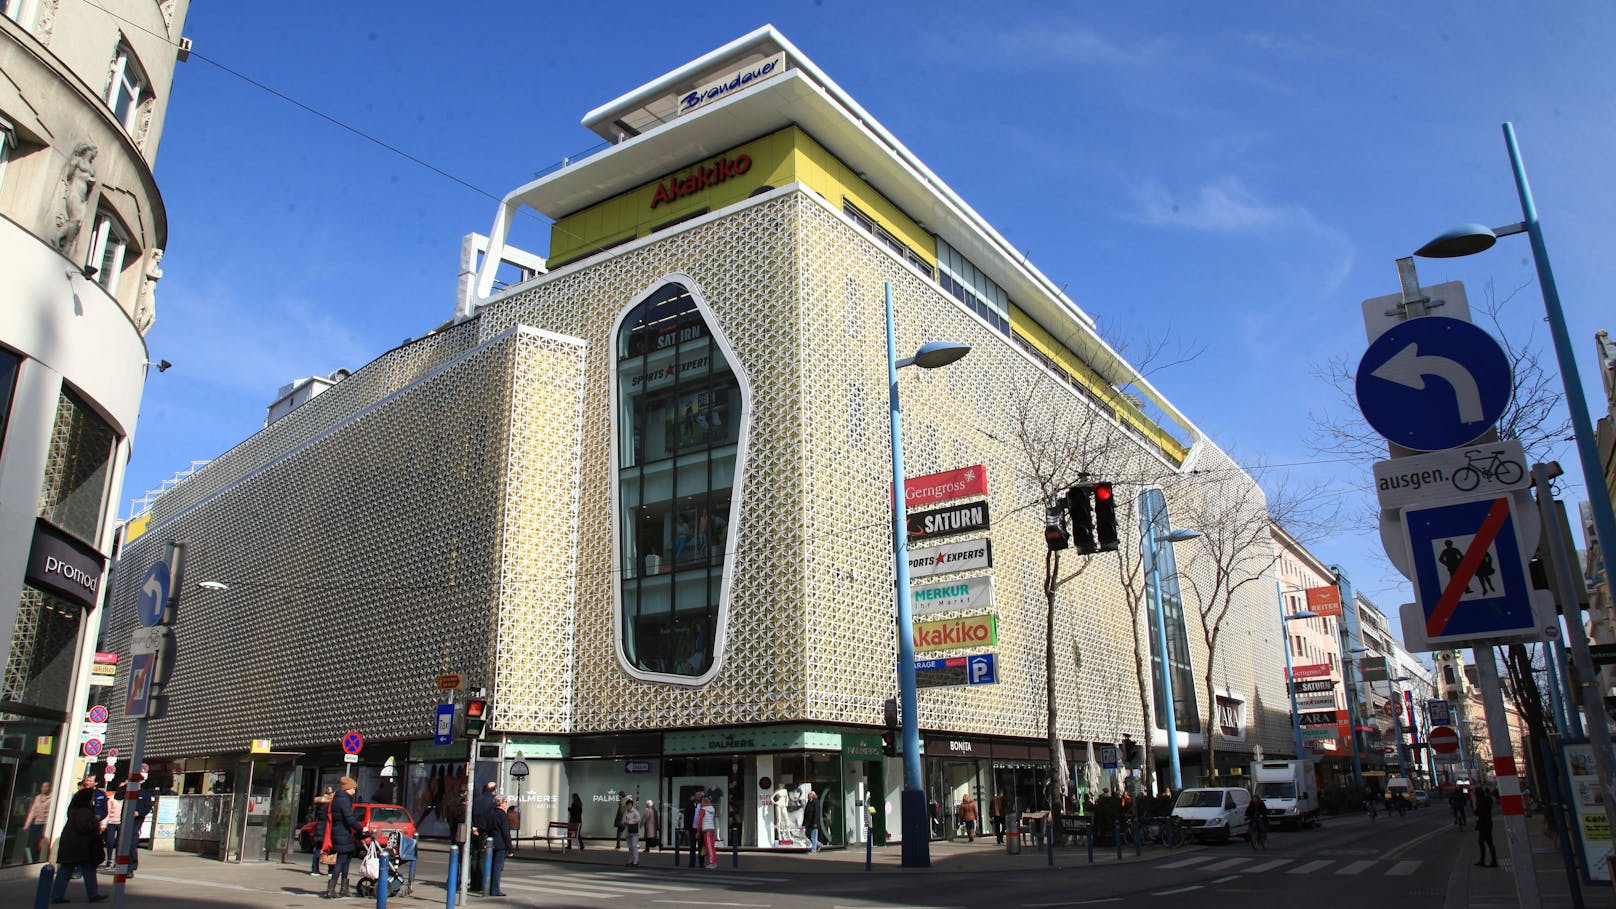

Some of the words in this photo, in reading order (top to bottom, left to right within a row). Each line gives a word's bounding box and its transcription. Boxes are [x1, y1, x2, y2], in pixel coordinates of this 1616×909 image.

[680, 59, 779, 112] Brandauer
[650, 154, 752, 209] Akakiko
[632, 368, 665, 386] SPRTS
[1380, 469, 1448, 490] ausgen.
[905, 480, 966, 500] Gerngross
[924, 507, 983, 533] SATURN
[909, 556, 934, 568] PORTS
[946, 549, 984, 562] EXPERTS
[45, 555, 98, 592] promod
[915, 584, 970, 602] MERKUR
[1311, 602, 1339, 611] REITER
[972, 662, 988, 683] P
[1302, 681, 1331, 691] SATURN
[1299, 712, 1330, 724] ZARA
[950, 739, 972, 753] BONITA
[508, 794, 558, 802] PALMERS
[592, 794, 633, 802] PALMES
